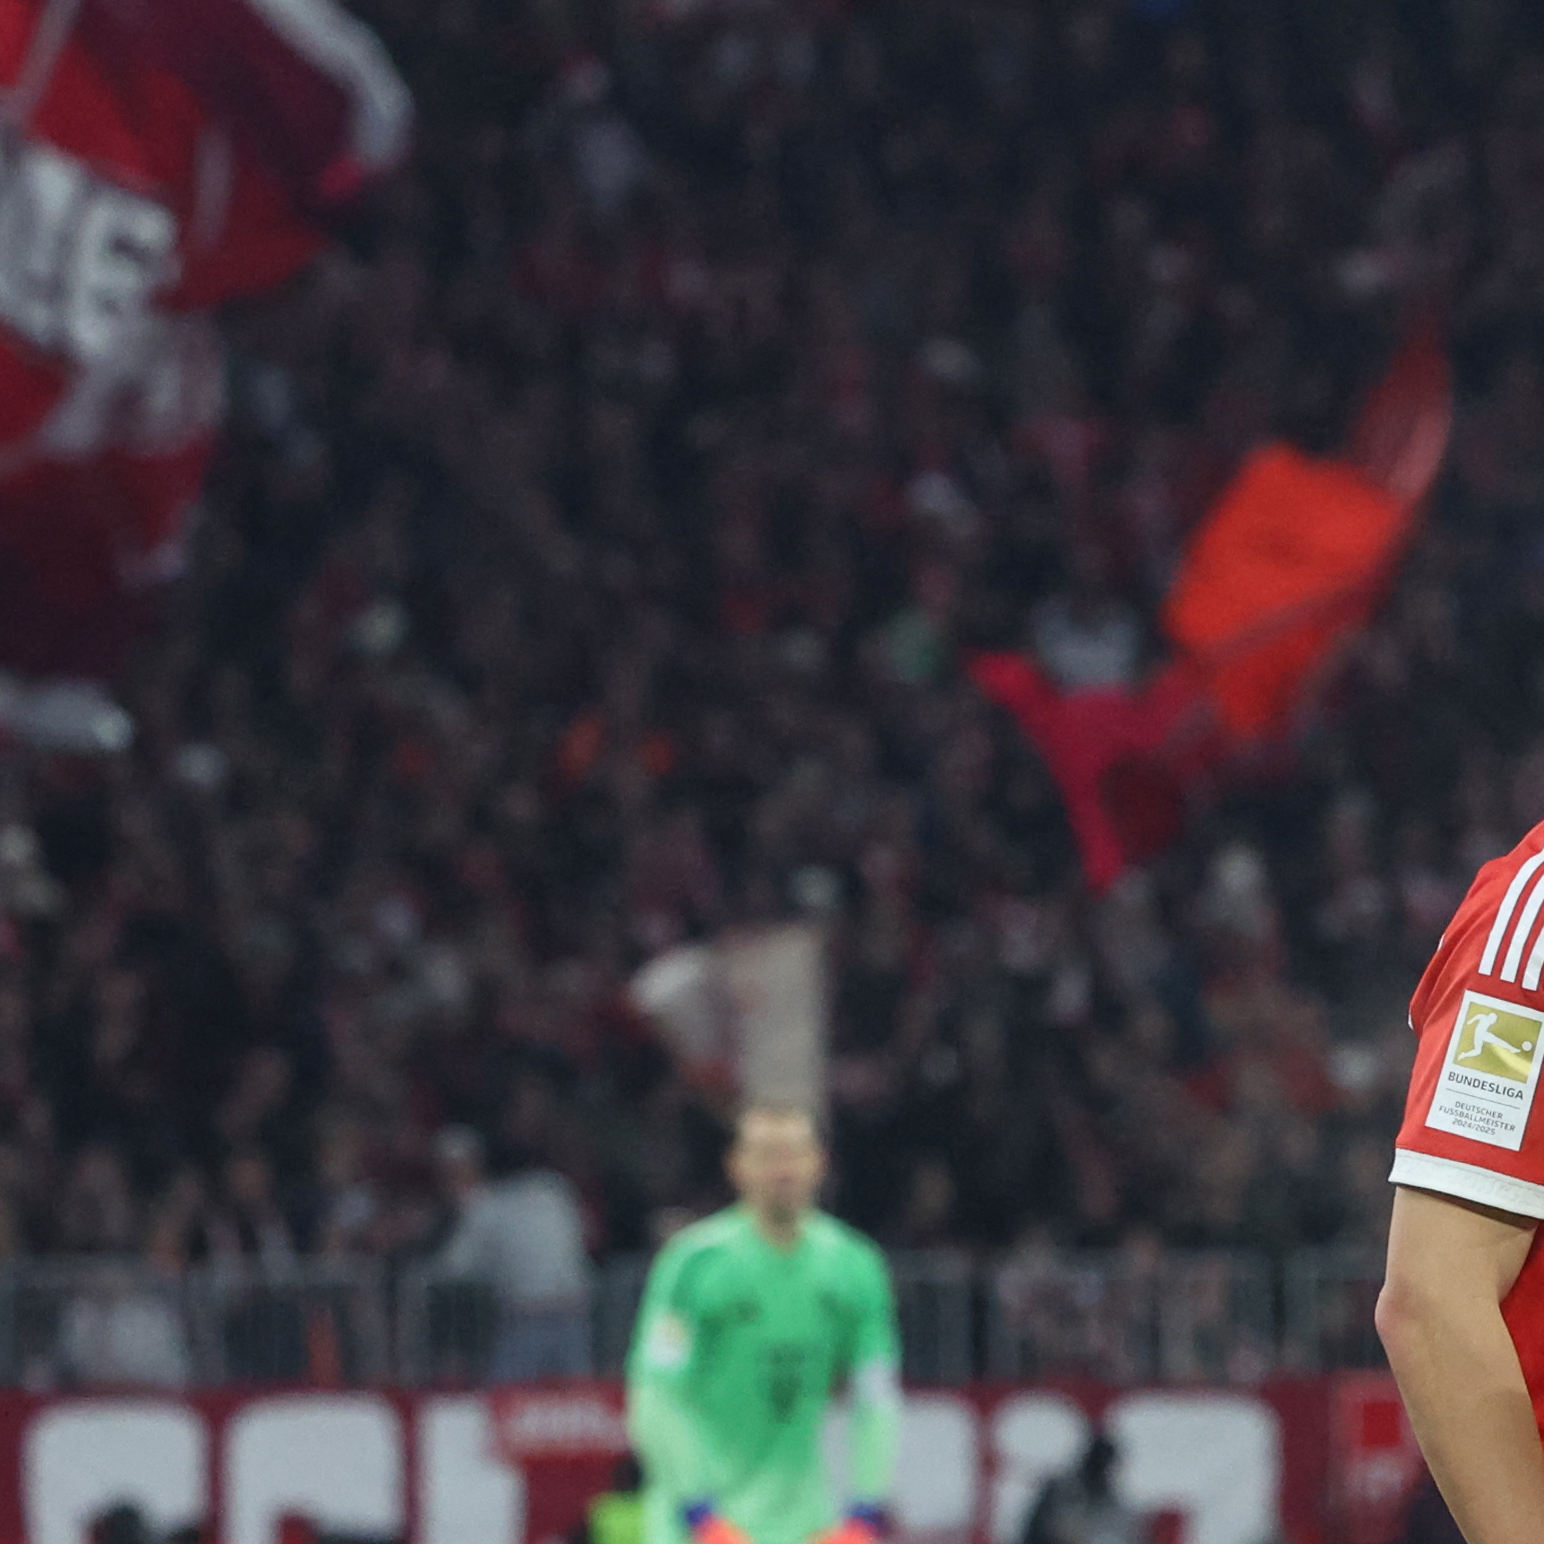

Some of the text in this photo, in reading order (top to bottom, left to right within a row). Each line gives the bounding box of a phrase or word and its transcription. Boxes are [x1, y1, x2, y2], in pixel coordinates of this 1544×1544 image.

[1447, 1071, 1524, 1100] BUNDESLIGA
[1438, 1105, 1516, 1132] FUSSBALLMEISTER
[1454, 1101, 1504, 1120] DEUTSCHER
[1451, 1118, 1496, 1136] 2024/2025
